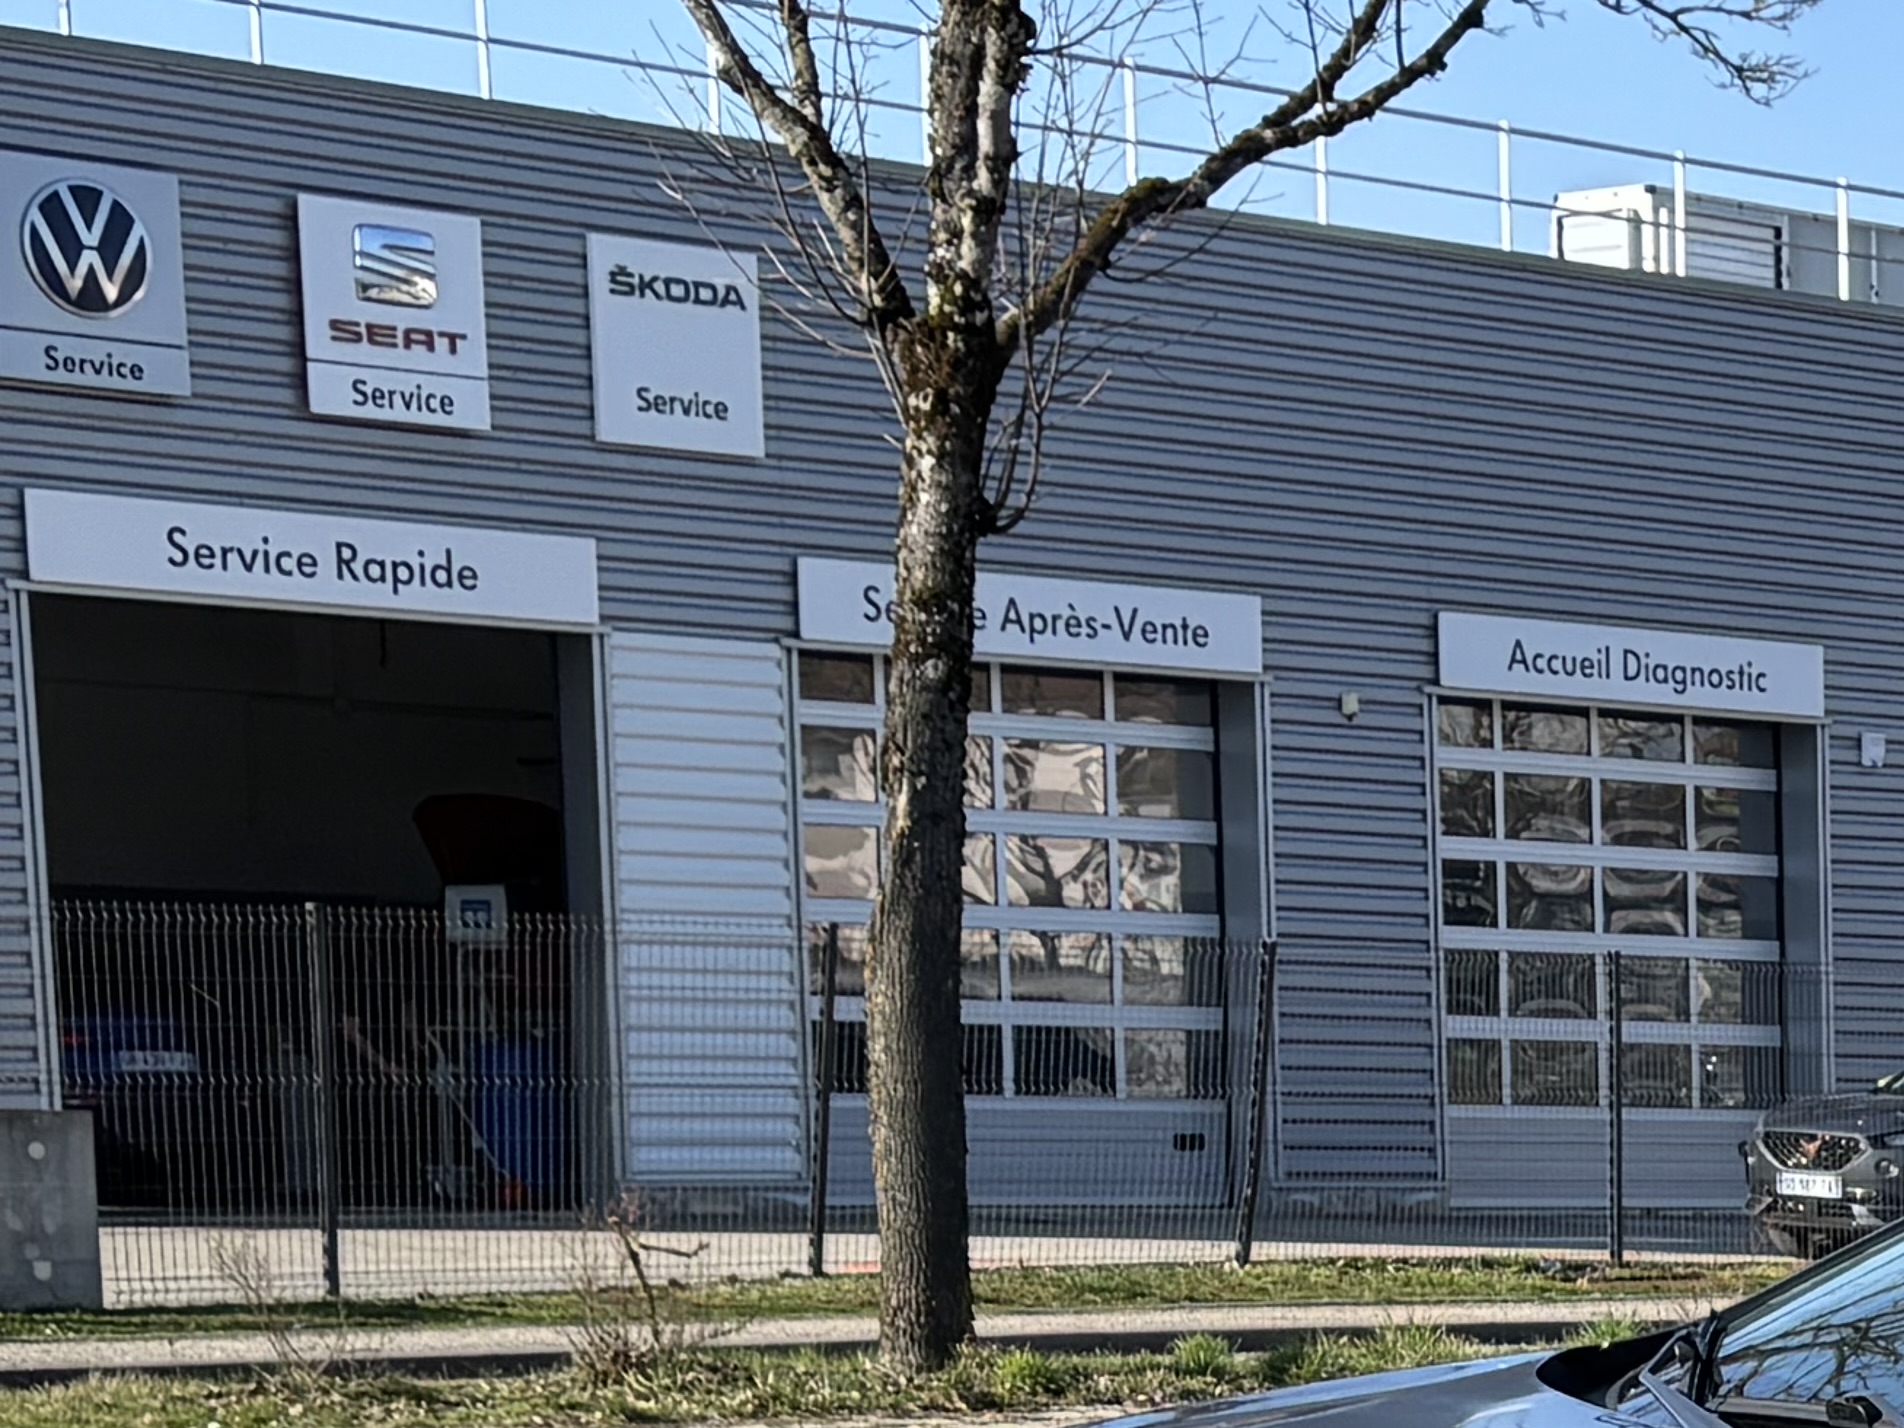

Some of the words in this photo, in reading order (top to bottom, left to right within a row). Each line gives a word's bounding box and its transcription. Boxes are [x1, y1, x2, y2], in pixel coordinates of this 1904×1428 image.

[608, 264, 748, 312] ŠKODA
[328, 318, 468, 356] SEAT
[43, 345, 145, 381] Service
[351, 378, 455, 415] Service
[636, 386, 730, 421] Service
[166, 526, 319, 579] Service
[334, 541, 479, 596] Rapide
[999, 597, 1211, 649] Après-Vente
[1507, 639, 1612, 680] Accueil
[1622, 649, 1769, 695] Diagnostic
